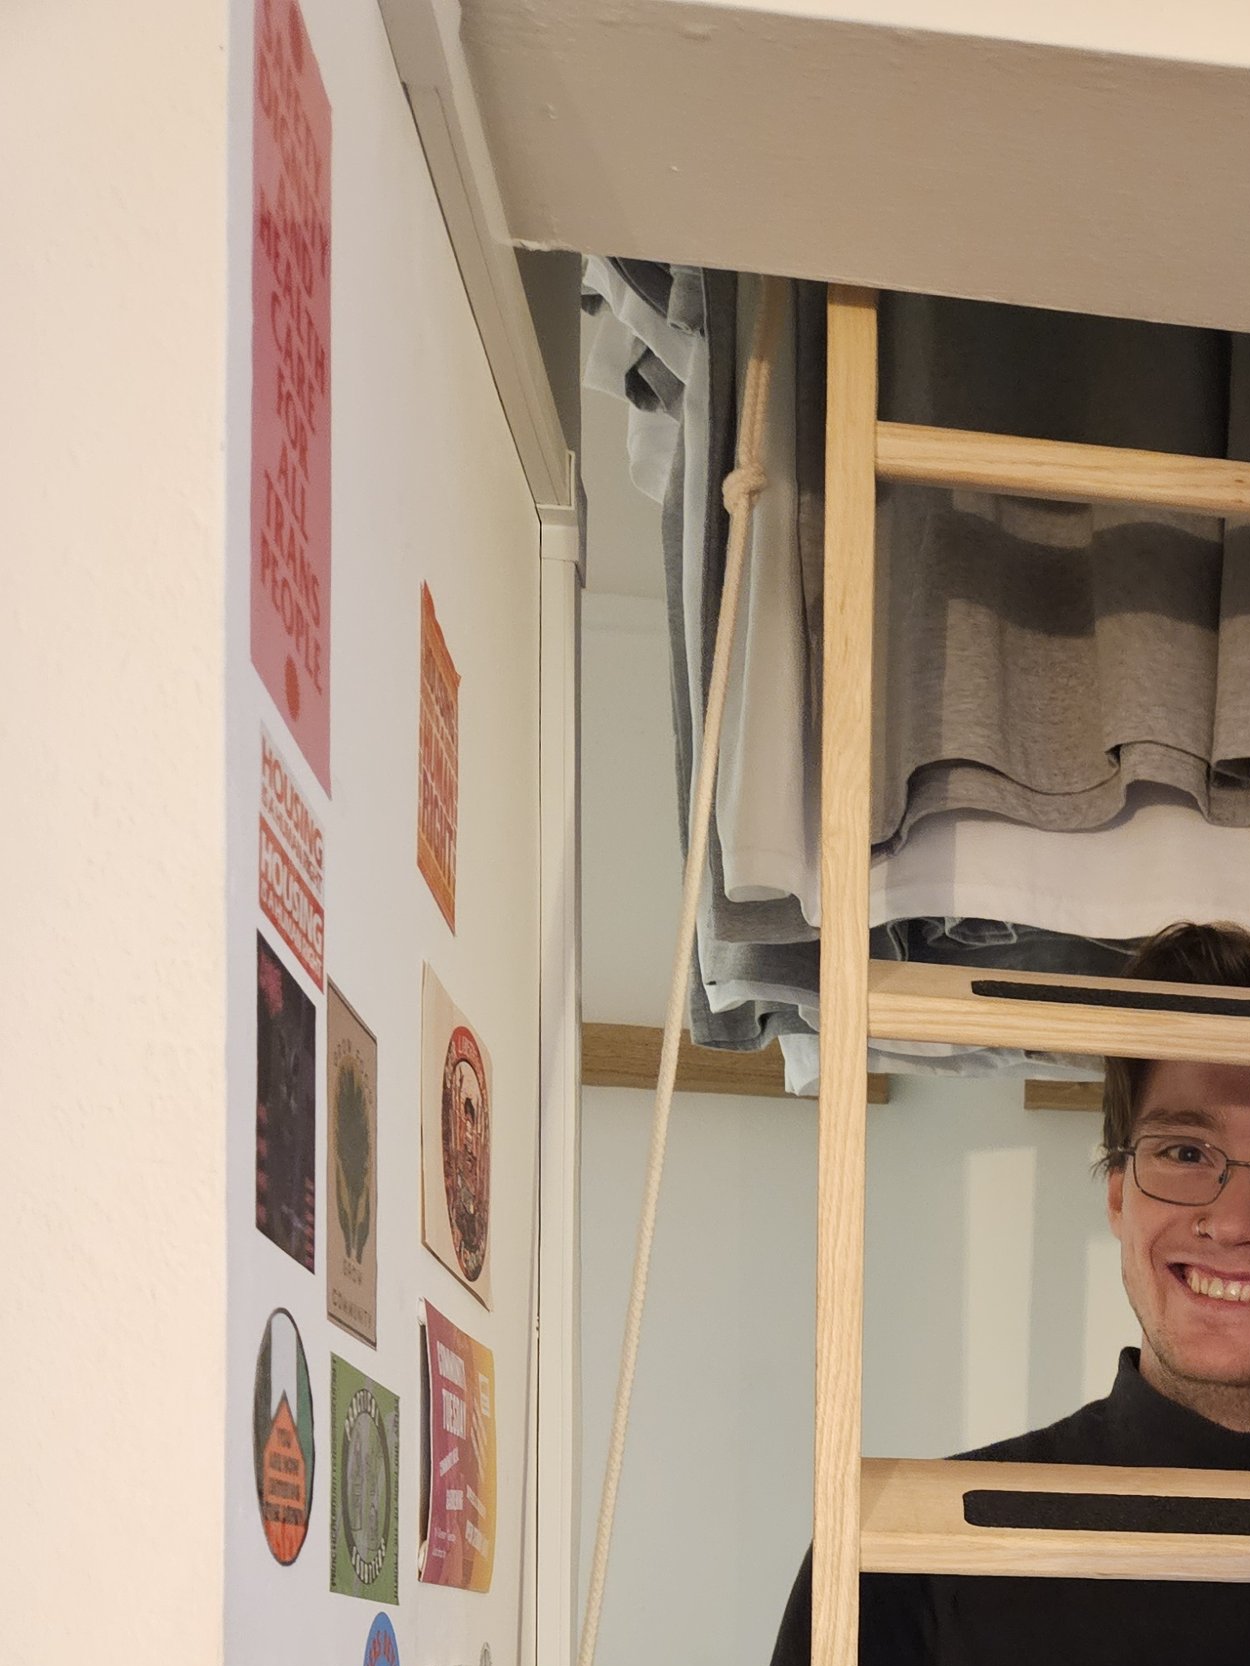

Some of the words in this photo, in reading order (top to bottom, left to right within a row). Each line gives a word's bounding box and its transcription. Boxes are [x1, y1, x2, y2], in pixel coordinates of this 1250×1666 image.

[258, 45, 327, 285] DIGNITY
[277, 166, 313, 304] AND
[259, 185, 325, 399] HEALTH
[270, 284, 315, 436] CARE
[277, 363, 308, 482] FOR
[278, 431, 308, 544] ALL
[260, 529, 321, 698] PEOPLE
[263, 466, 320, 633] TRANS
[262, 733, 322, 871] HOUSING
[261, 828, 322, 957] HOUSING
